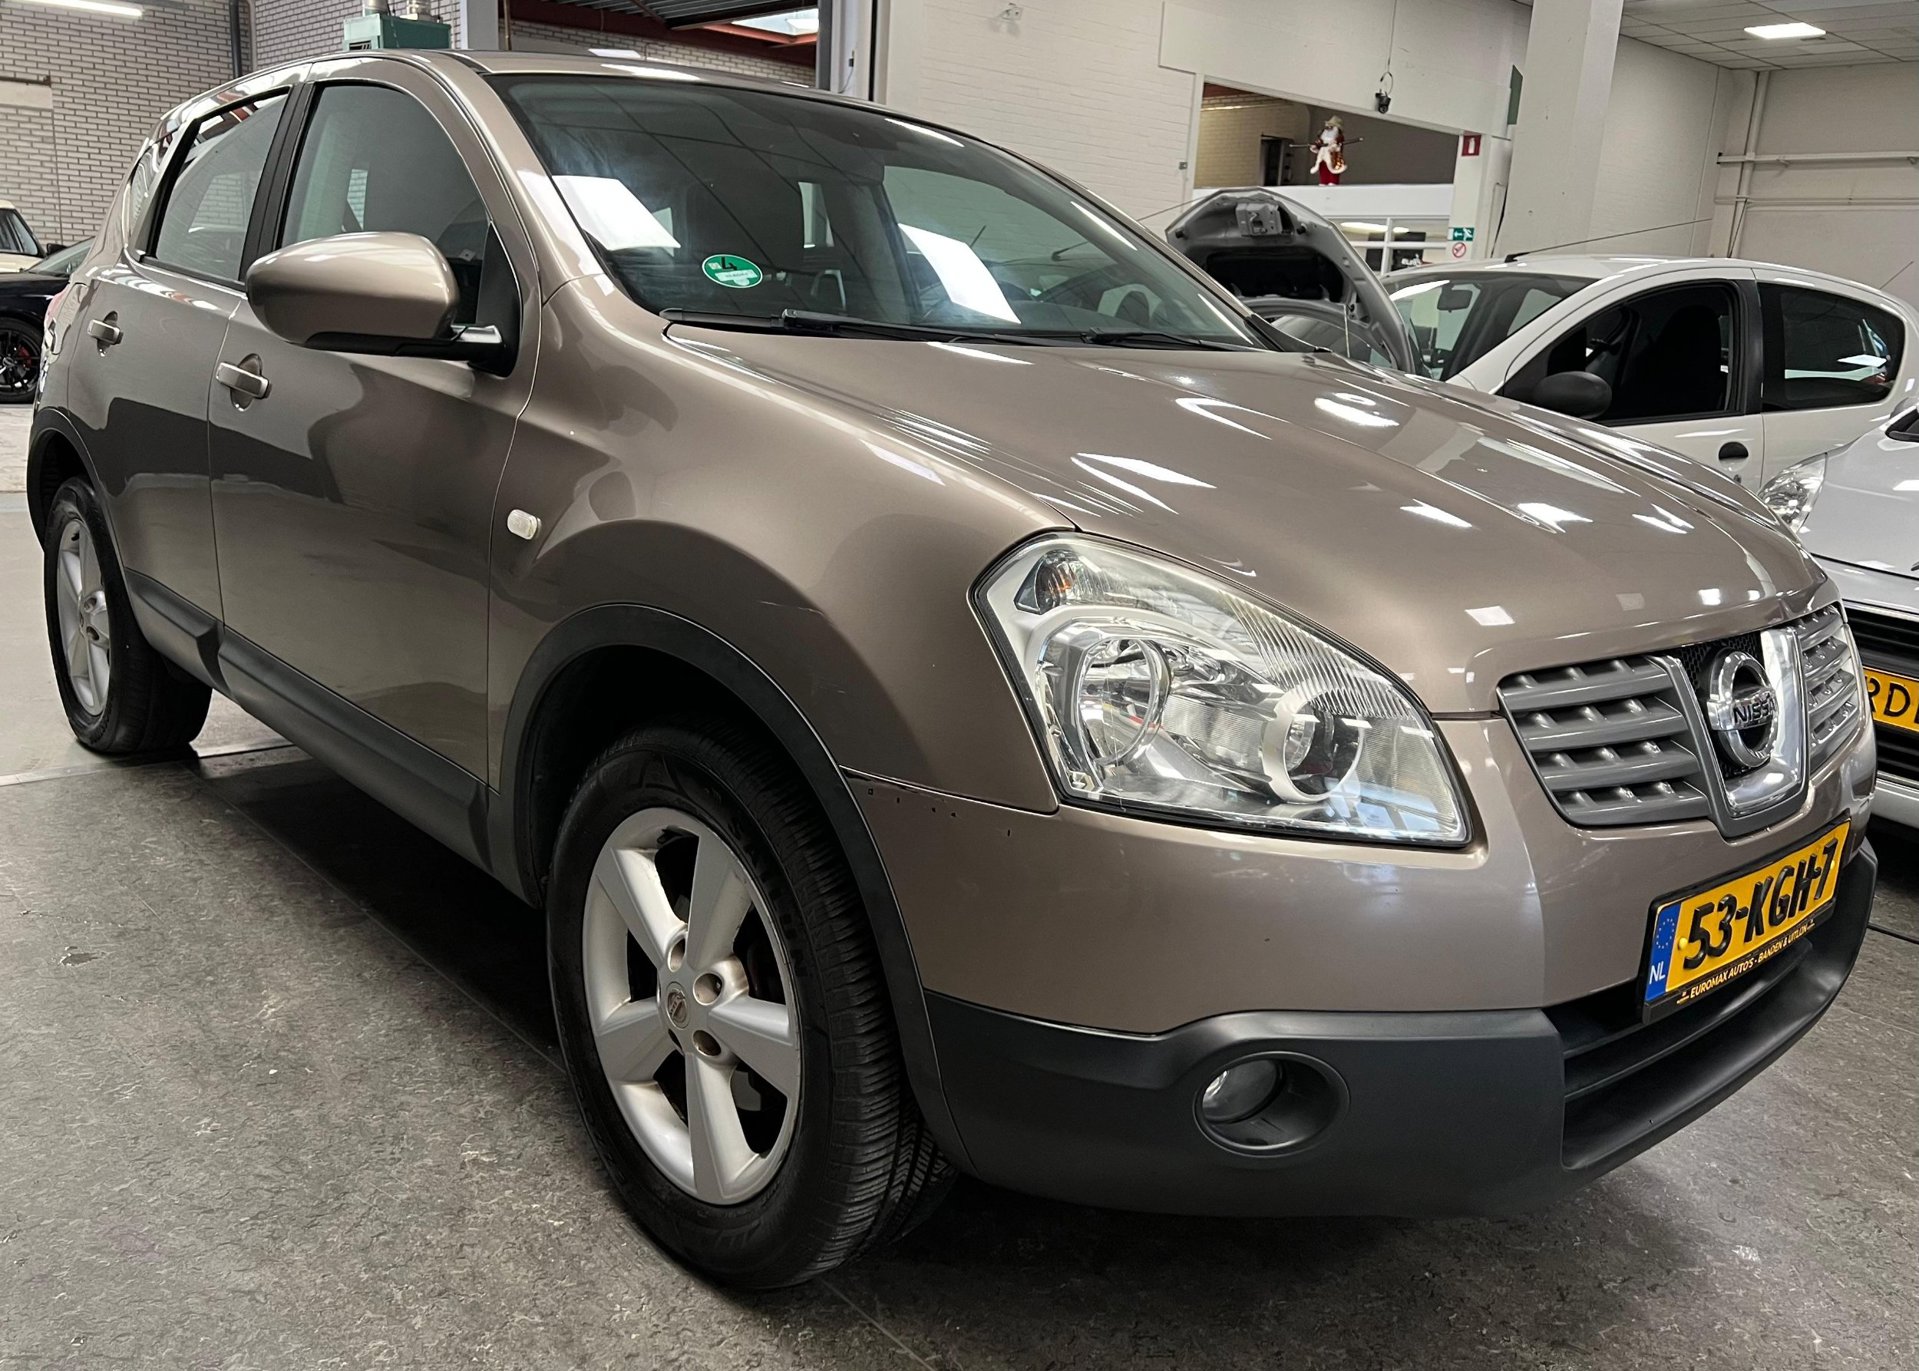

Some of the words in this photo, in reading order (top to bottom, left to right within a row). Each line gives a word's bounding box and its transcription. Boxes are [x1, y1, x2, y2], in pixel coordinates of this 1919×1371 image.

[1865, 675, 1919, 724] RD
[1683, 838, 1838, 970] 53-KGH-7
[1649, 961, 1666, 985] NL
[1690, 971, 1729, 999] EUROMAX
